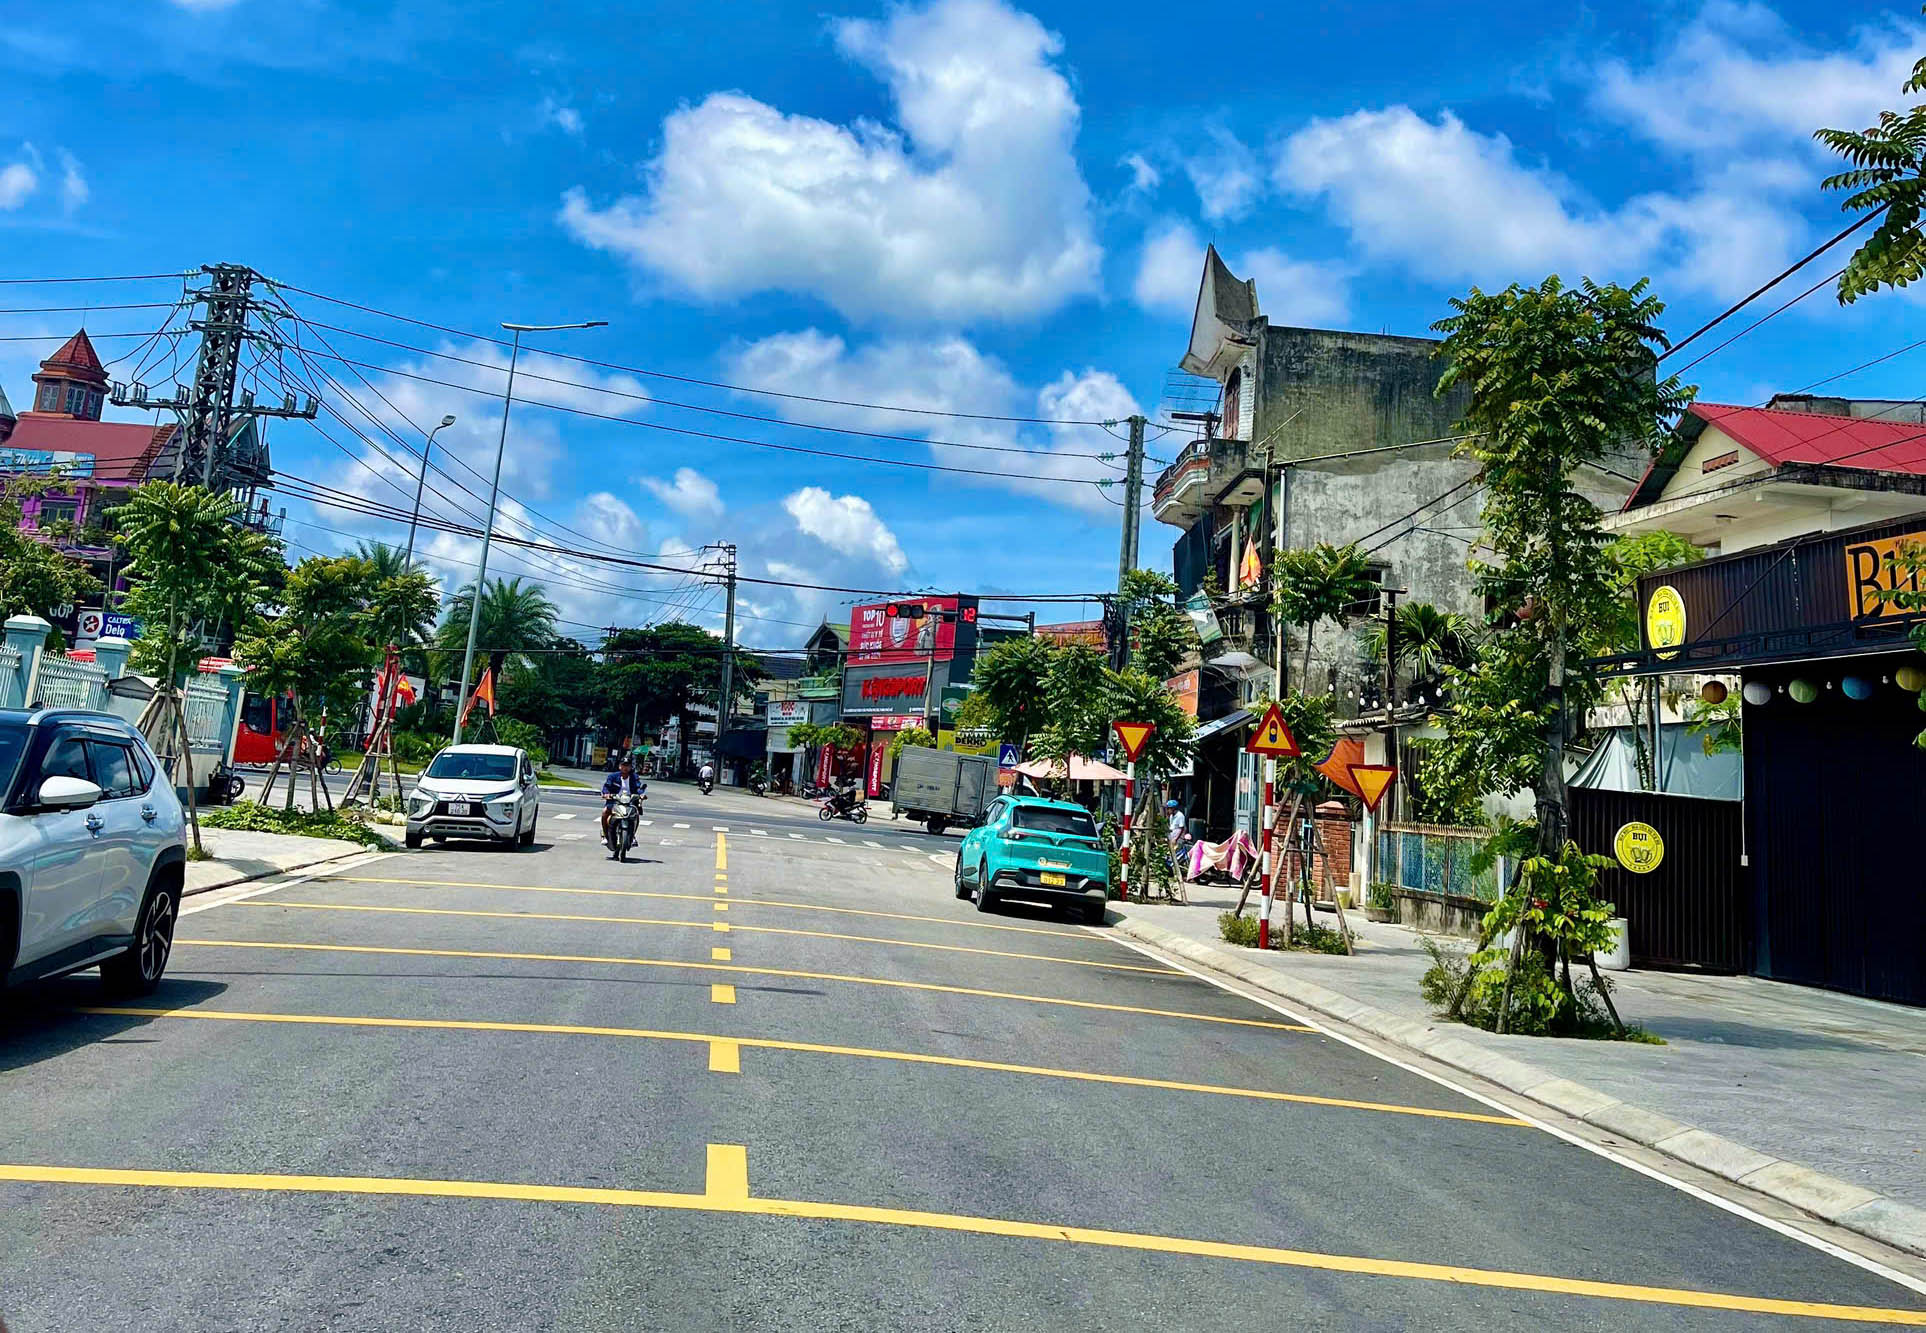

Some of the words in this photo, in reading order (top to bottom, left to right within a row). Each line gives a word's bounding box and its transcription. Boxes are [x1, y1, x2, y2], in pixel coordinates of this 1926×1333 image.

[107, 616, 132, 625] CALTEX
[863, 609, 876, 622] TOP
[876, 610, 886, 628] 10
[963, 607, 977, 623] 12
